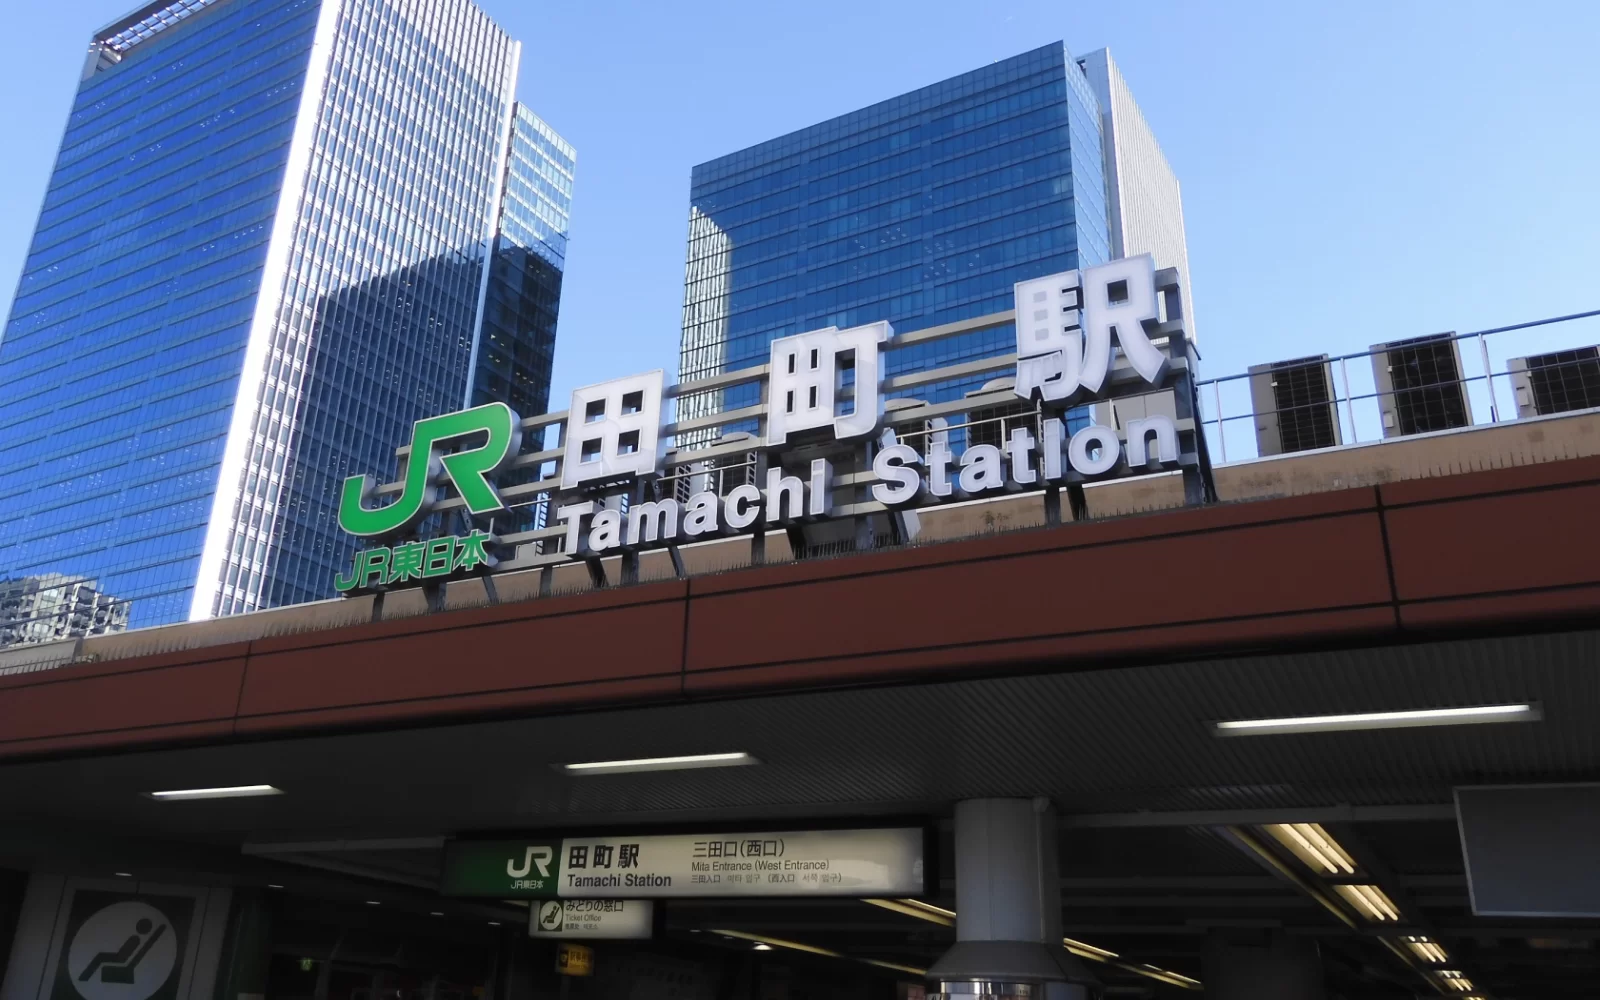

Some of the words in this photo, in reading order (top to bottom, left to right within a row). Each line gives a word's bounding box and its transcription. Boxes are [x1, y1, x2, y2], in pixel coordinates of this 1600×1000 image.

[561, 253, 1170, 490] 田町駅
[338, 402, 514, 536] JR
[557, 458, 829, 556] Tamachi
[871, 414, 1179, 505] Station
[334, 528, 490, 592] JR東日本
[506, 846, 553, 878] JR
[568, 844, 640, 869] 田町駅
[691, 862, 710, 872] Mita
[712, 861, 752, 871] Entrance
[754, 860, 782, 872] (West
[784, 859, 830, 870] Entrance)
[510, 879, 544, 890] JR東日本
[567, 874, 621, 888] Tamachi
[624, 873, 672, 887] Station
[565, 913, 583, 922] Ticket
[584, 913, 602, 922] Office
